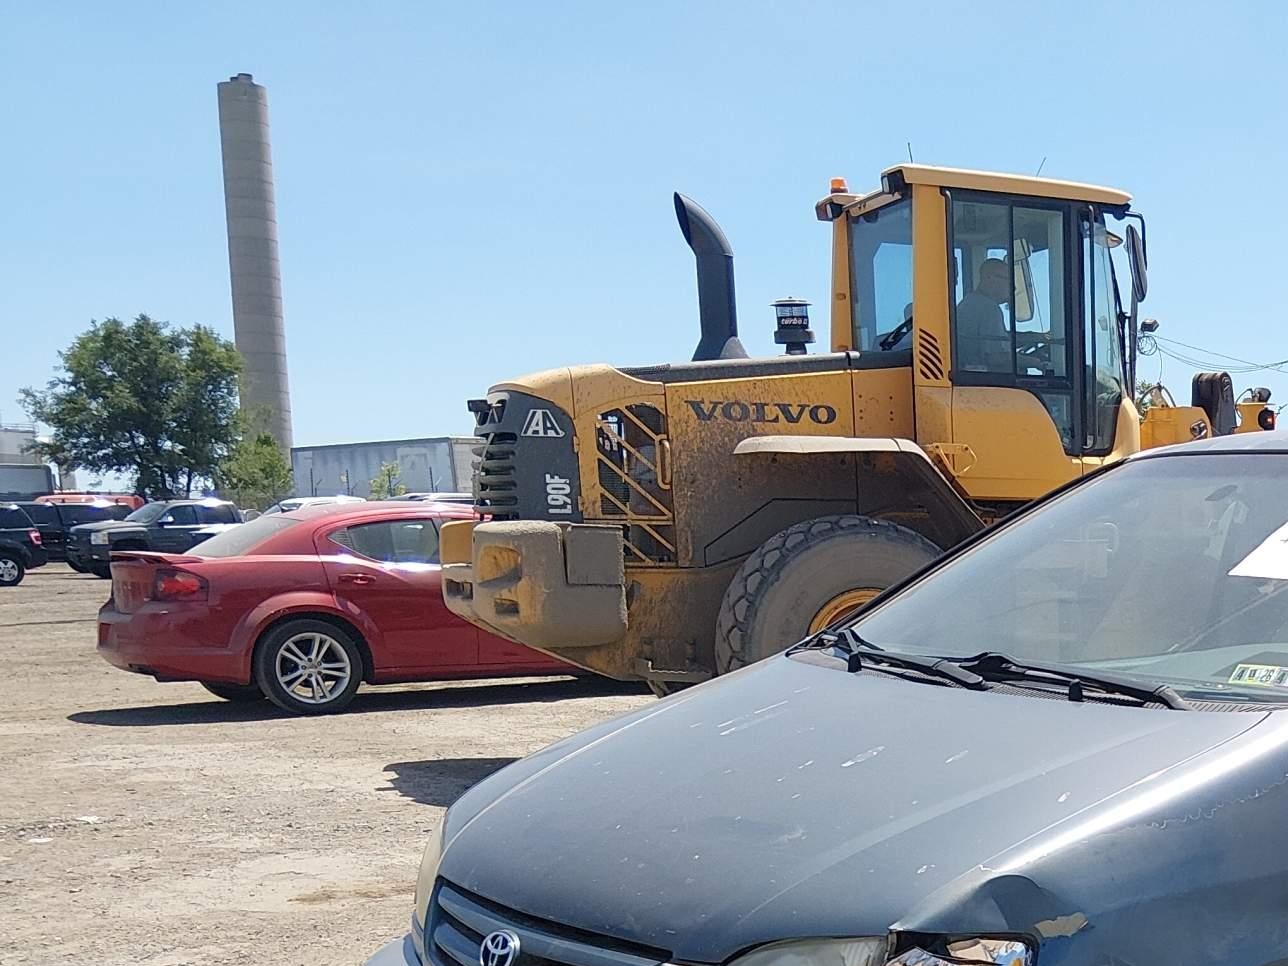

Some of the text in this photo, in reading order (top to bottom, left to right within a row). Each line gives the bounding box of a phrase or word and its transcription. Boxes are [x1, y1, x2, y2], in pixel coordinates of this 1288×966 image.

[781, 317, 802, 325] turbo
[684, 400, 837, 424] VOLVO
[545, 473, 573, 514] L90F
